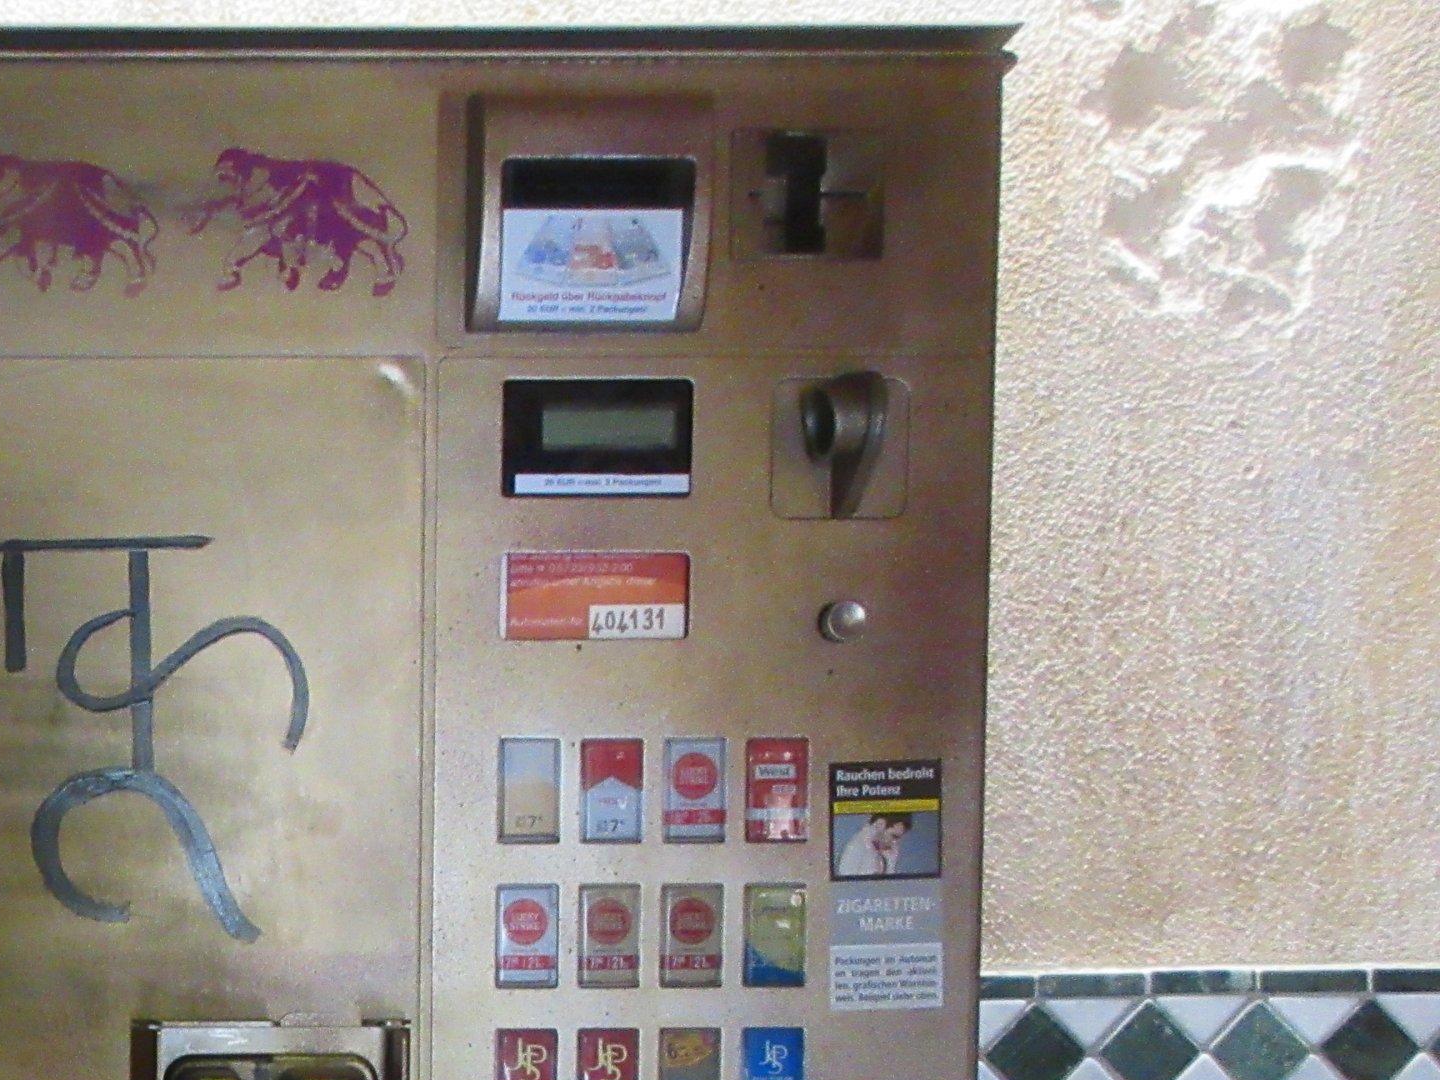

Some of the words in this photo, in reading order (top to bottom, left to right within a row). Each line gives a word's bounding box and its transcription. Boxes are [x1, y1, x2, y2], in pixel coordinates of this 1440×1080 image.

[591, 607, 665, 634] 404131
[836, 768, 885, 781] Rauchen
[888, 767, 935, 780] bedroht
[836, 785, 859, 797] Ihre
[862, 784, 901, 796] Potenz
[837, 896, 936, 914] ZIGARETTEN-
[859, 916, 914, 931] MARKE
